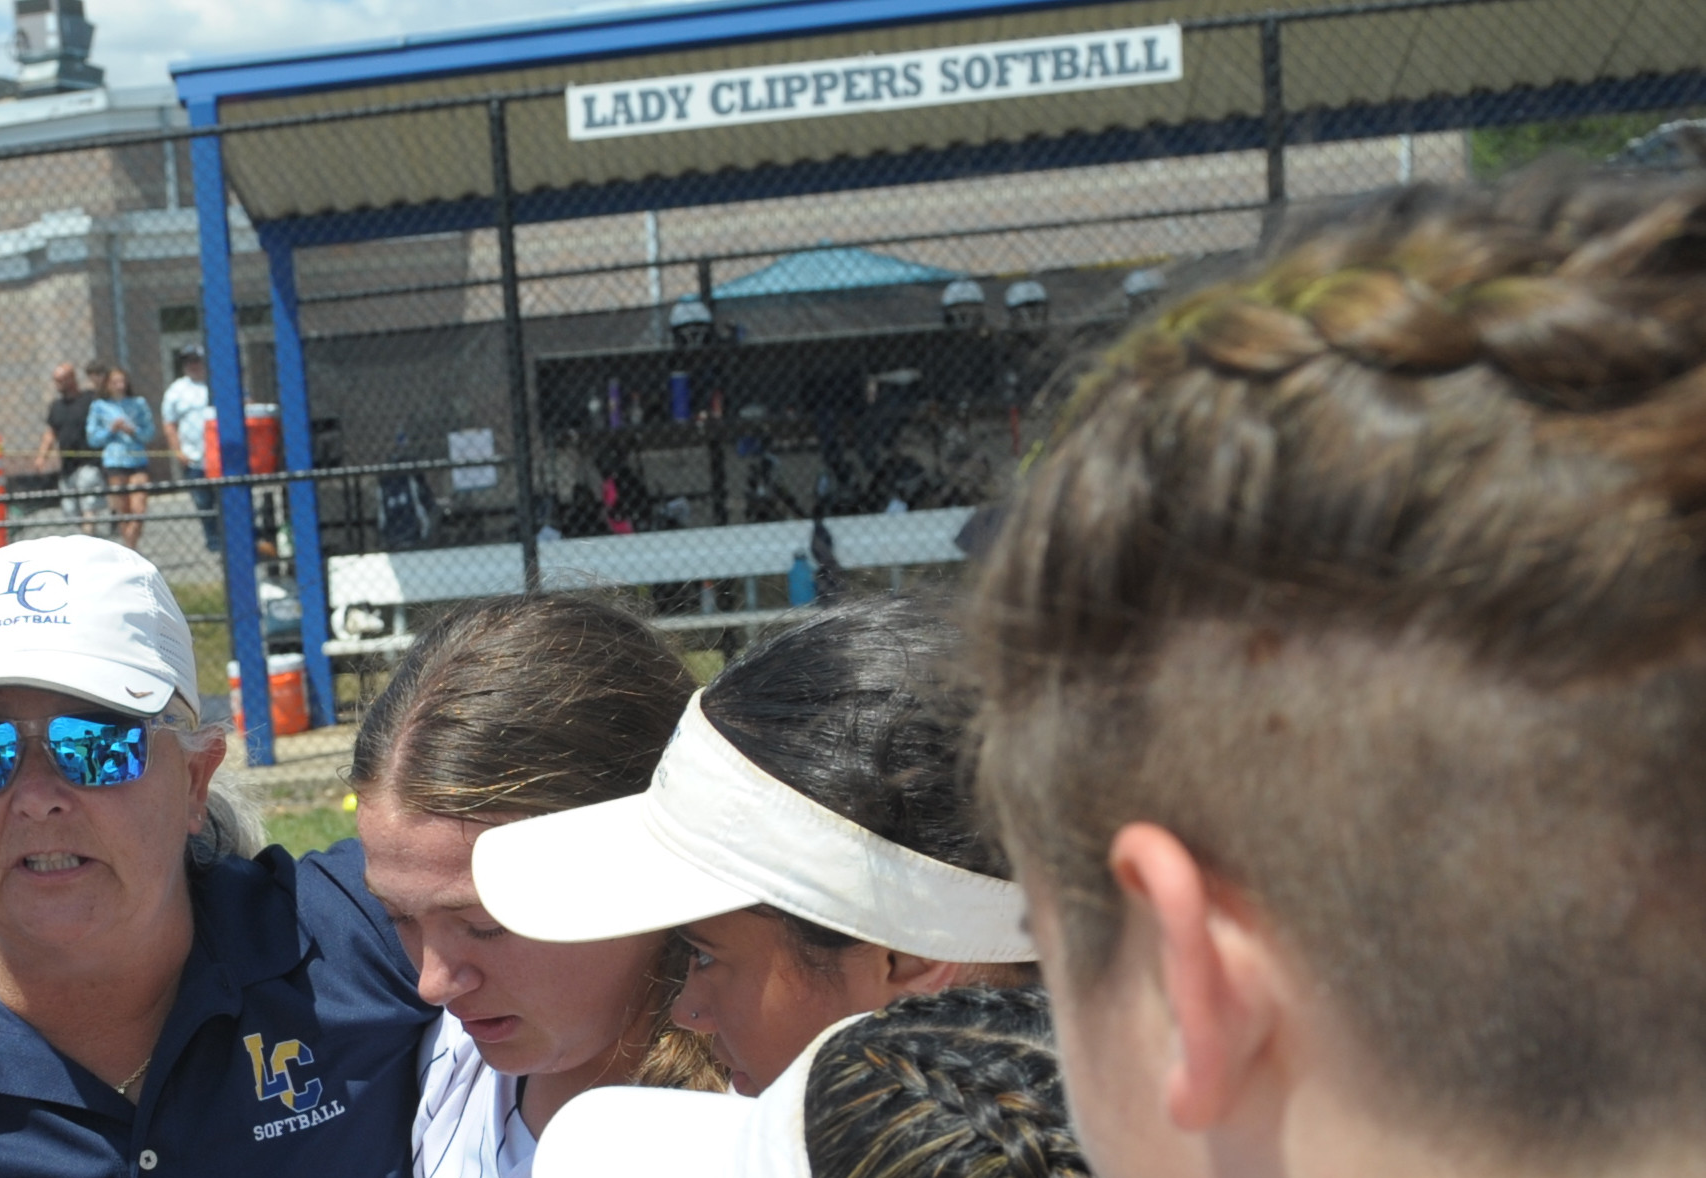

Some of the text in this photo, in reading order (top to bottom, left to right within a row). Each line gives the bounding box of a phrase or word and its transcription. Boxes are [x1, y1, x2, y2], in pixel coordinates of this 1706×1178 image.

[582, 37, 1170, 130] LADY CLIPPERS SOFTBALL
[243, 1032, 323, 1113] LC
[253, 1099, 346, 1142] SOFTBALL
